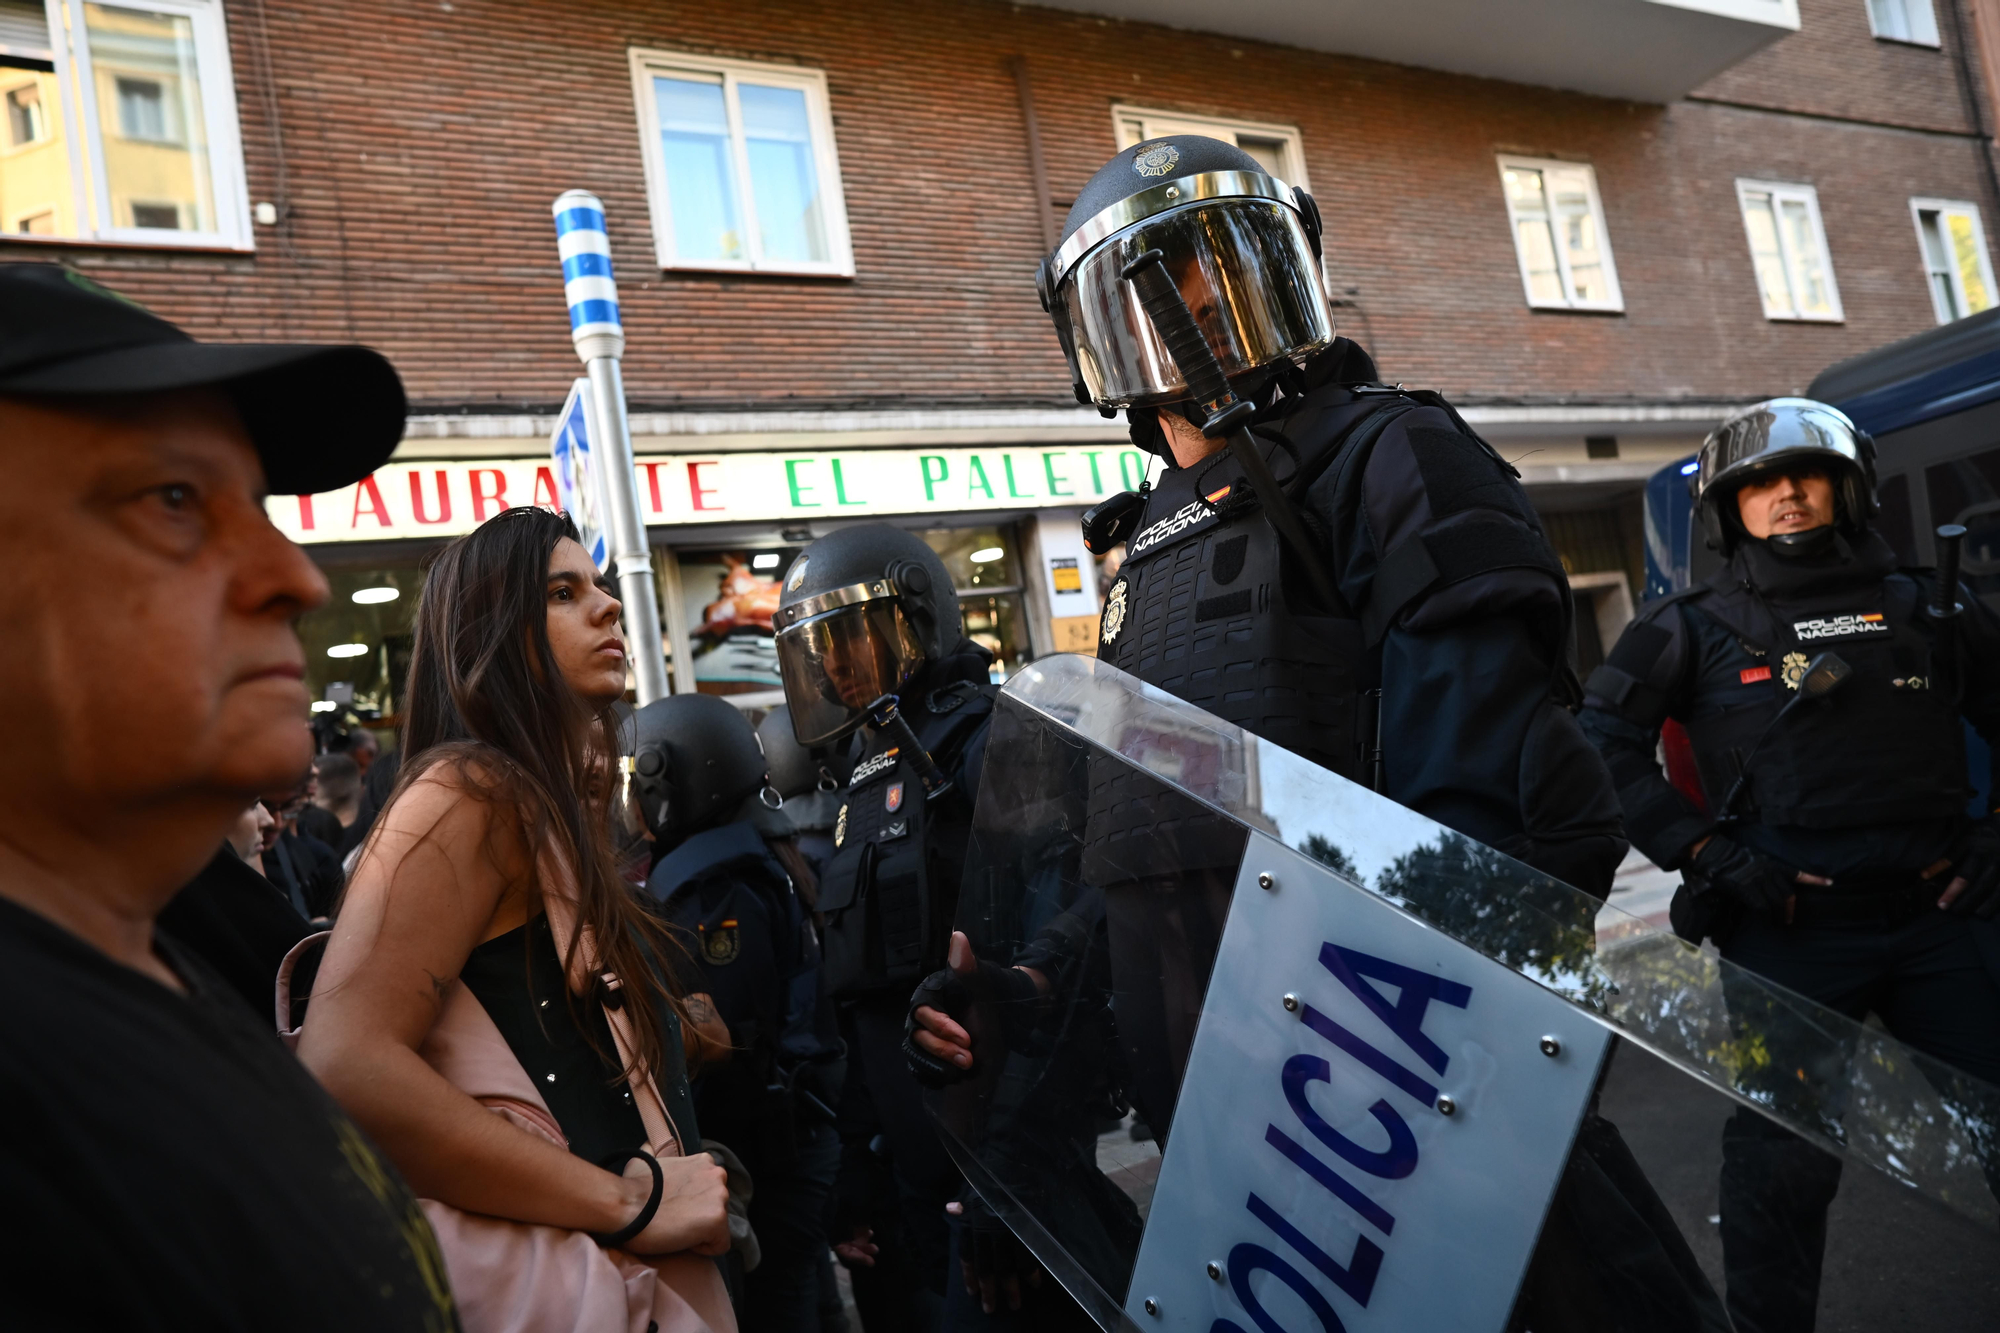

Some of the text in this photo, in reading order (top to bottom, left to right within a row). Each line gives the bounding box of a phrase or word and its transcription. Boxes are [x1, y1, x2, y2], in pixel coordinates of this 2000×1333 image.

[784, 458, 868, 508] EL
[919, 451, 1148, 502] PALETO
[1131, 503, 1217, 556] NACIONA
[1794, 615, 1867, 631] POLICIA
[1798, 623, 1888, 641] NACIONAL
[850, 758, 896, 785] NACIONAL
[853, 752, 889, 776] POLICIA
[1209, 941, 1473, 1333] OLICIA
